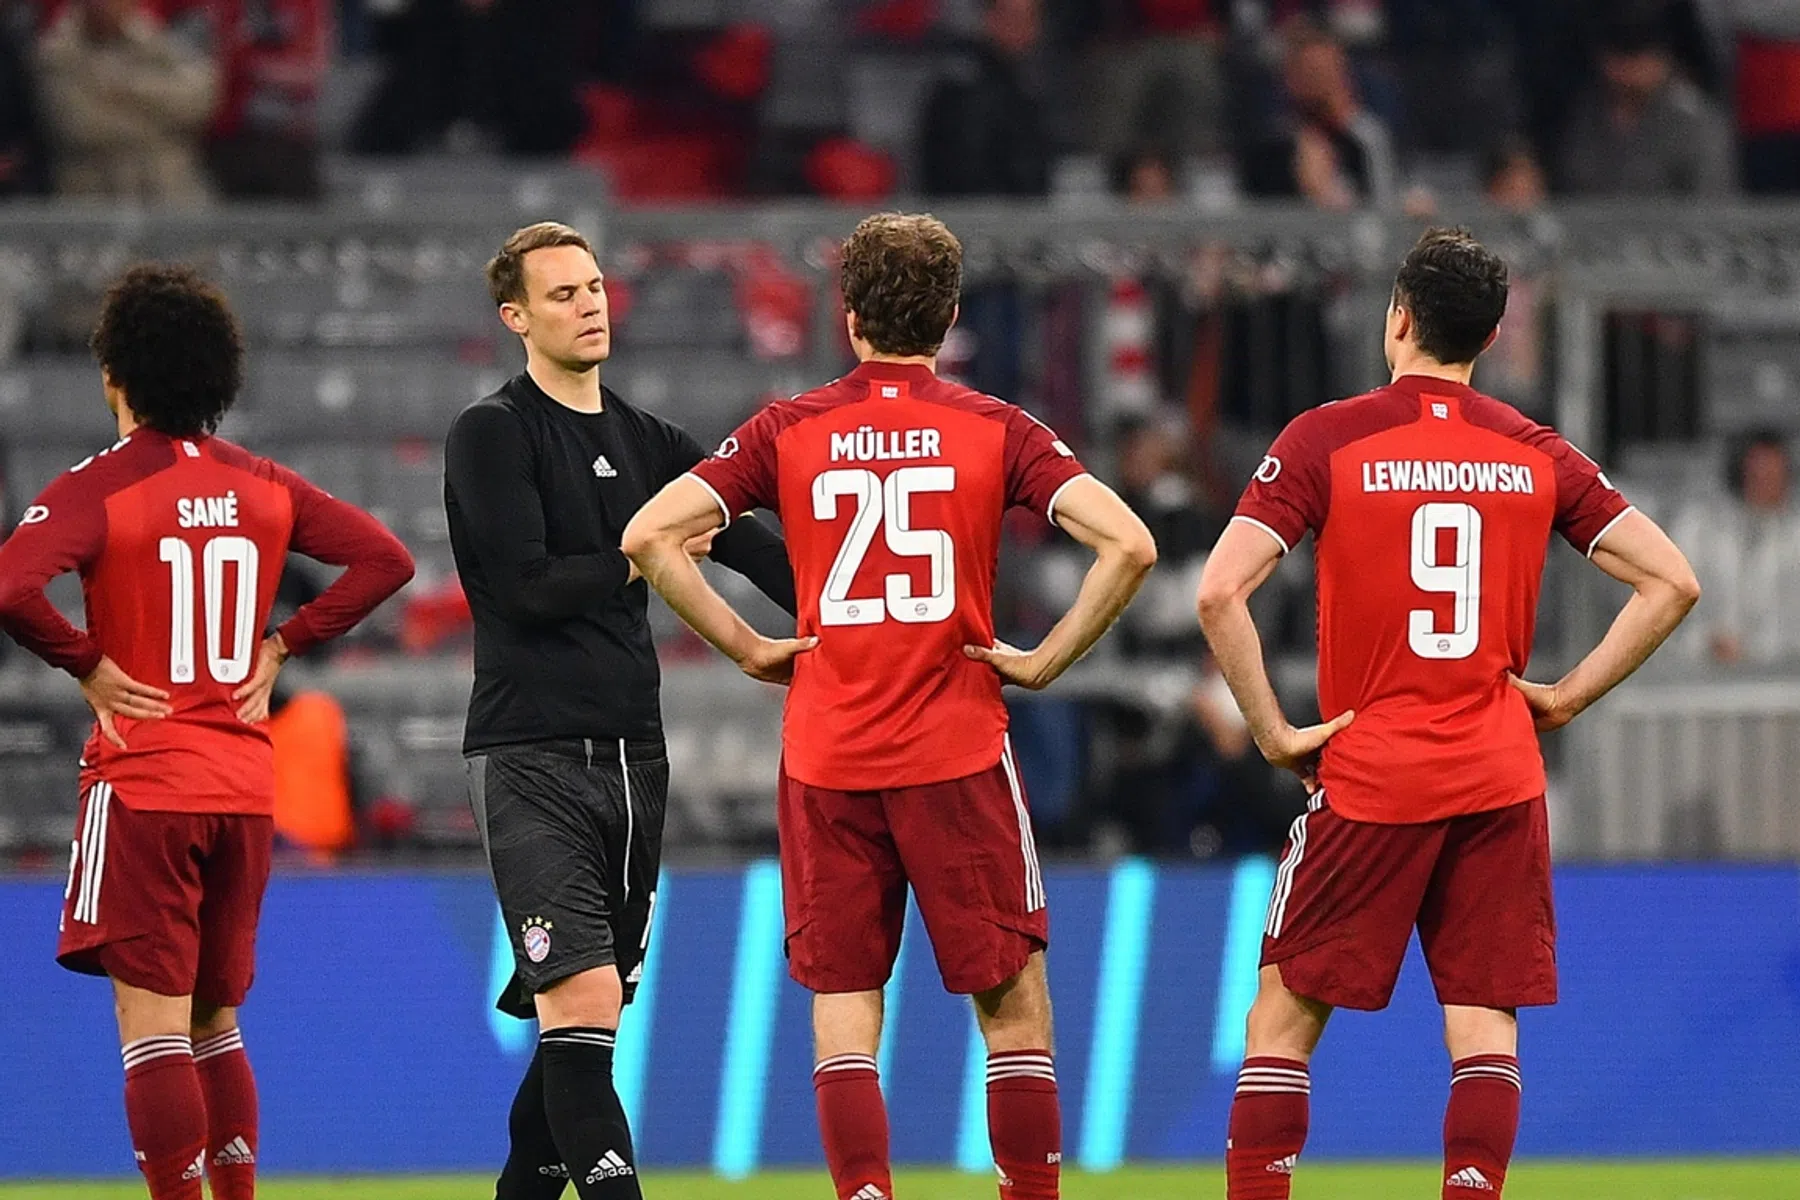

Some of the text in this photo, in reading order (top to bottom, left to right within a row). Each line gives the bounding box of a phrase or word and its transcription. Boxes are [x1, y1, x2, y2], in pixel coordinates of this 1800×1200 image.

[830, 426, 941, 461] MÜLLER
[1362, 460, 1534, 494] LEWANDOWSKI
[177, 490, 240, 528] SANÉ
[811, 466, 956, 626] 25
[1408, 502, 1483, 660] 9
[159, 536, 259, 684] 10
[212, 1151, 255, 1167] adidas
[585, 1165, 634, 1185] adidas
[1446, 1177, 1494, 1190] adidas
